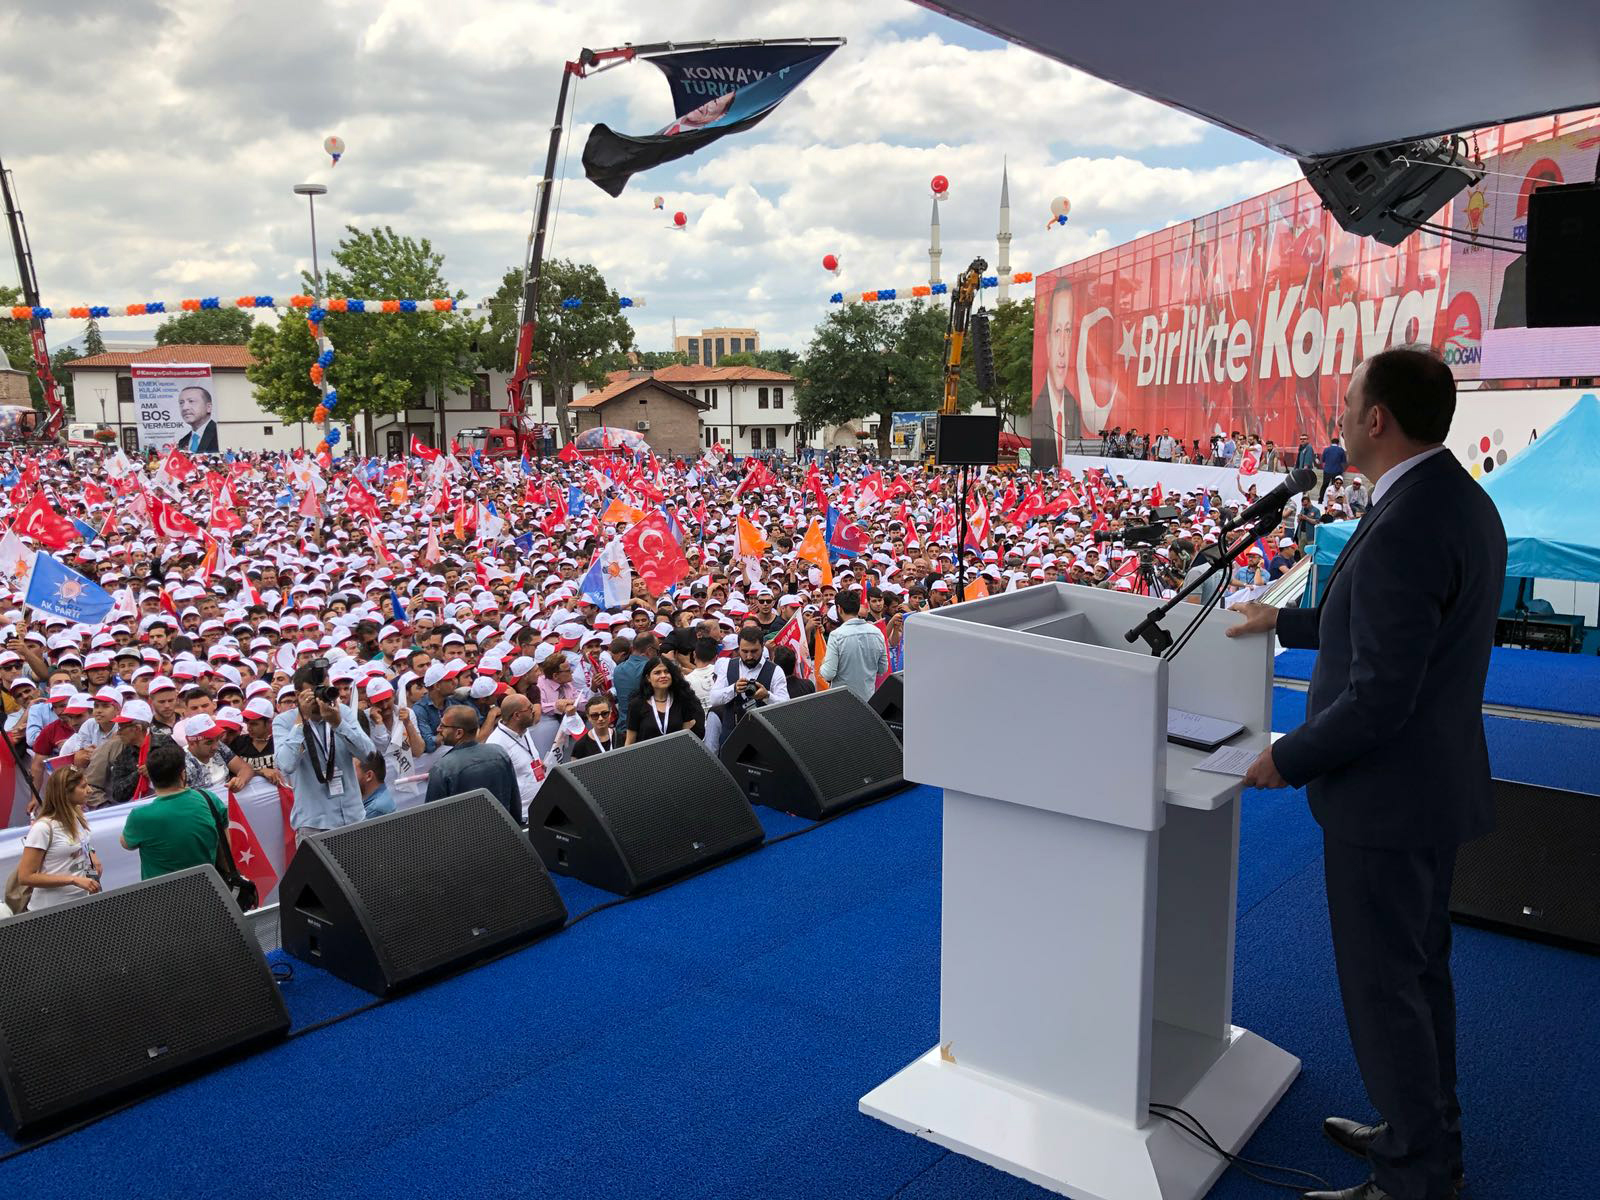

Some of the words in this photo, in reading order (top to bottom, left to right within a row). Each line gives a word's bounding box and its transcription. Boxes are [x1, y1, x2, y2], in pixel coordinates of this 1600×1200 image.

[683, 66, 773, 84] KONYA'Y
[1137, 304, 1252, 387] Birlikte
[142, 410, 170, 421] BOŞ
[41, 600, 52, 610] AK
